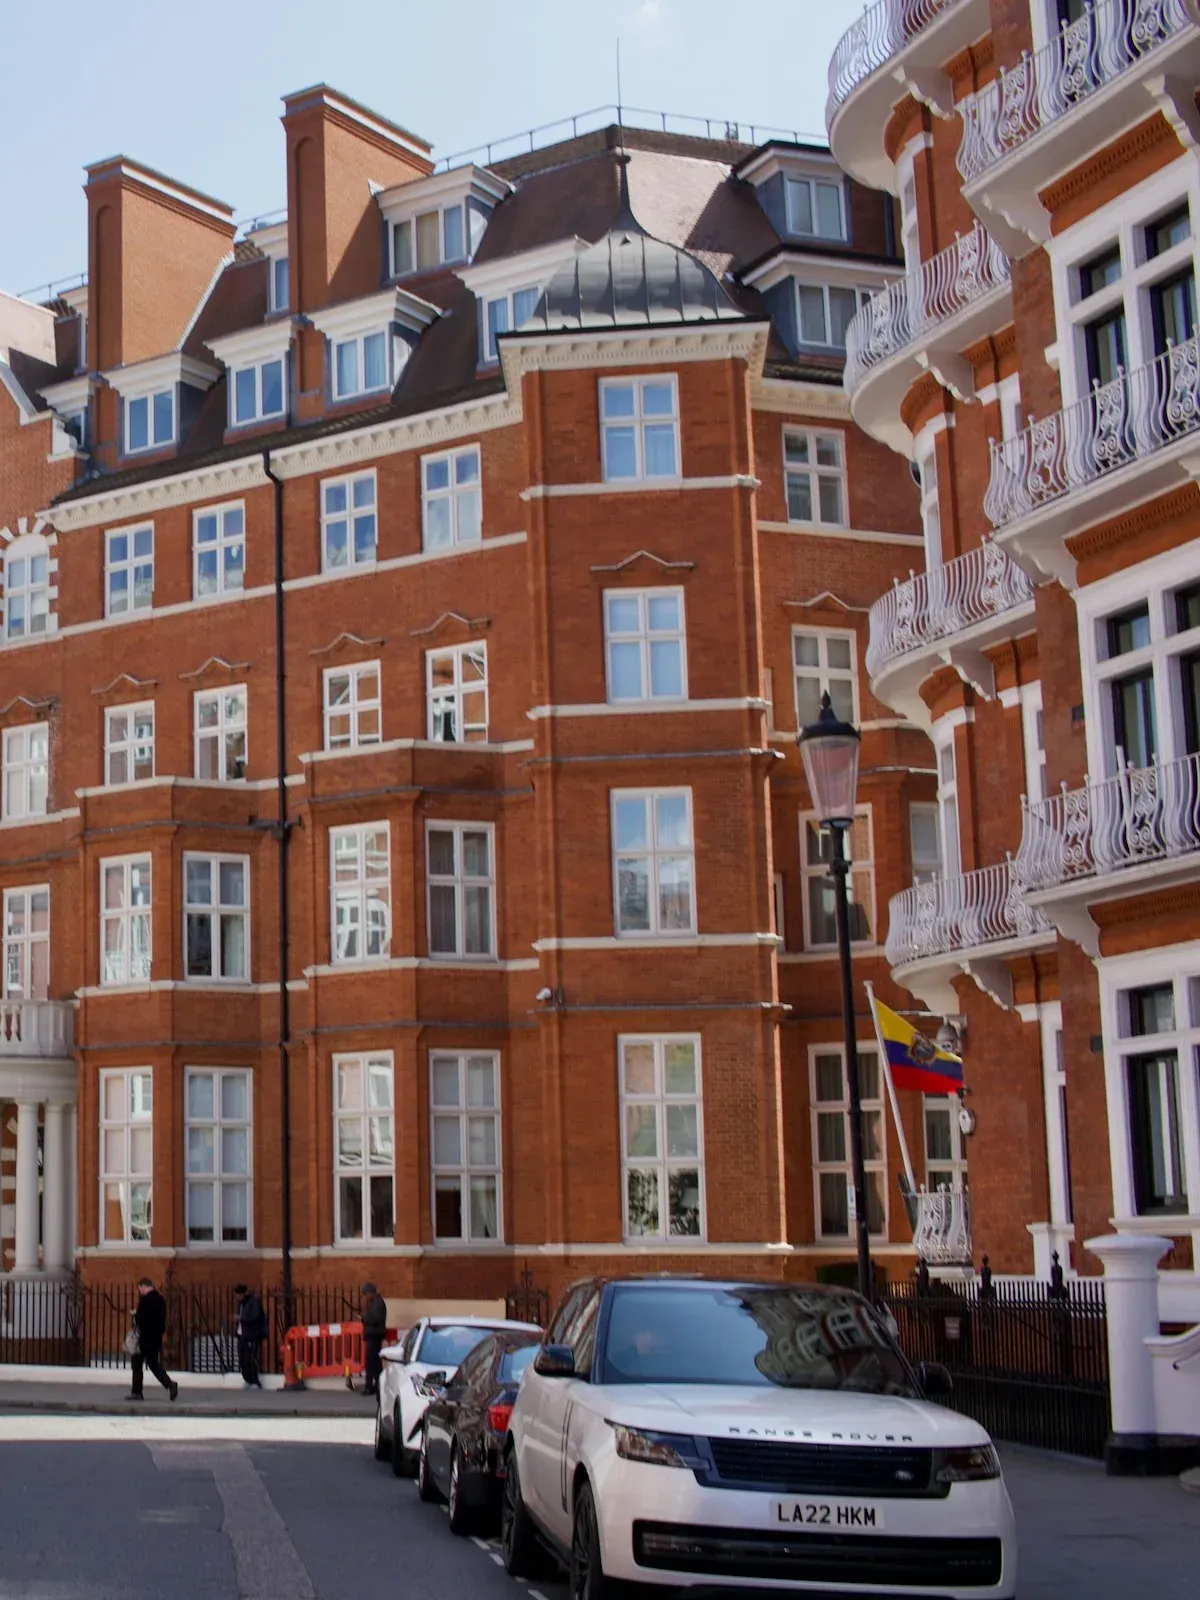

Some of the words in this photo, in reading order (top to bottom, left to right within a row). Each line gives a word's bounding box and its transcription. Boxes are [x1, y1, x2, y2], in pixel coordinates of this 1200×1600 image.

[729, 1427, 812, 1437] RANGE
[832, 1433, 912, 1442] ROVER
[777, 1503, 831, 1525] LA22
[837, 1506, 876, 1526] HKM
